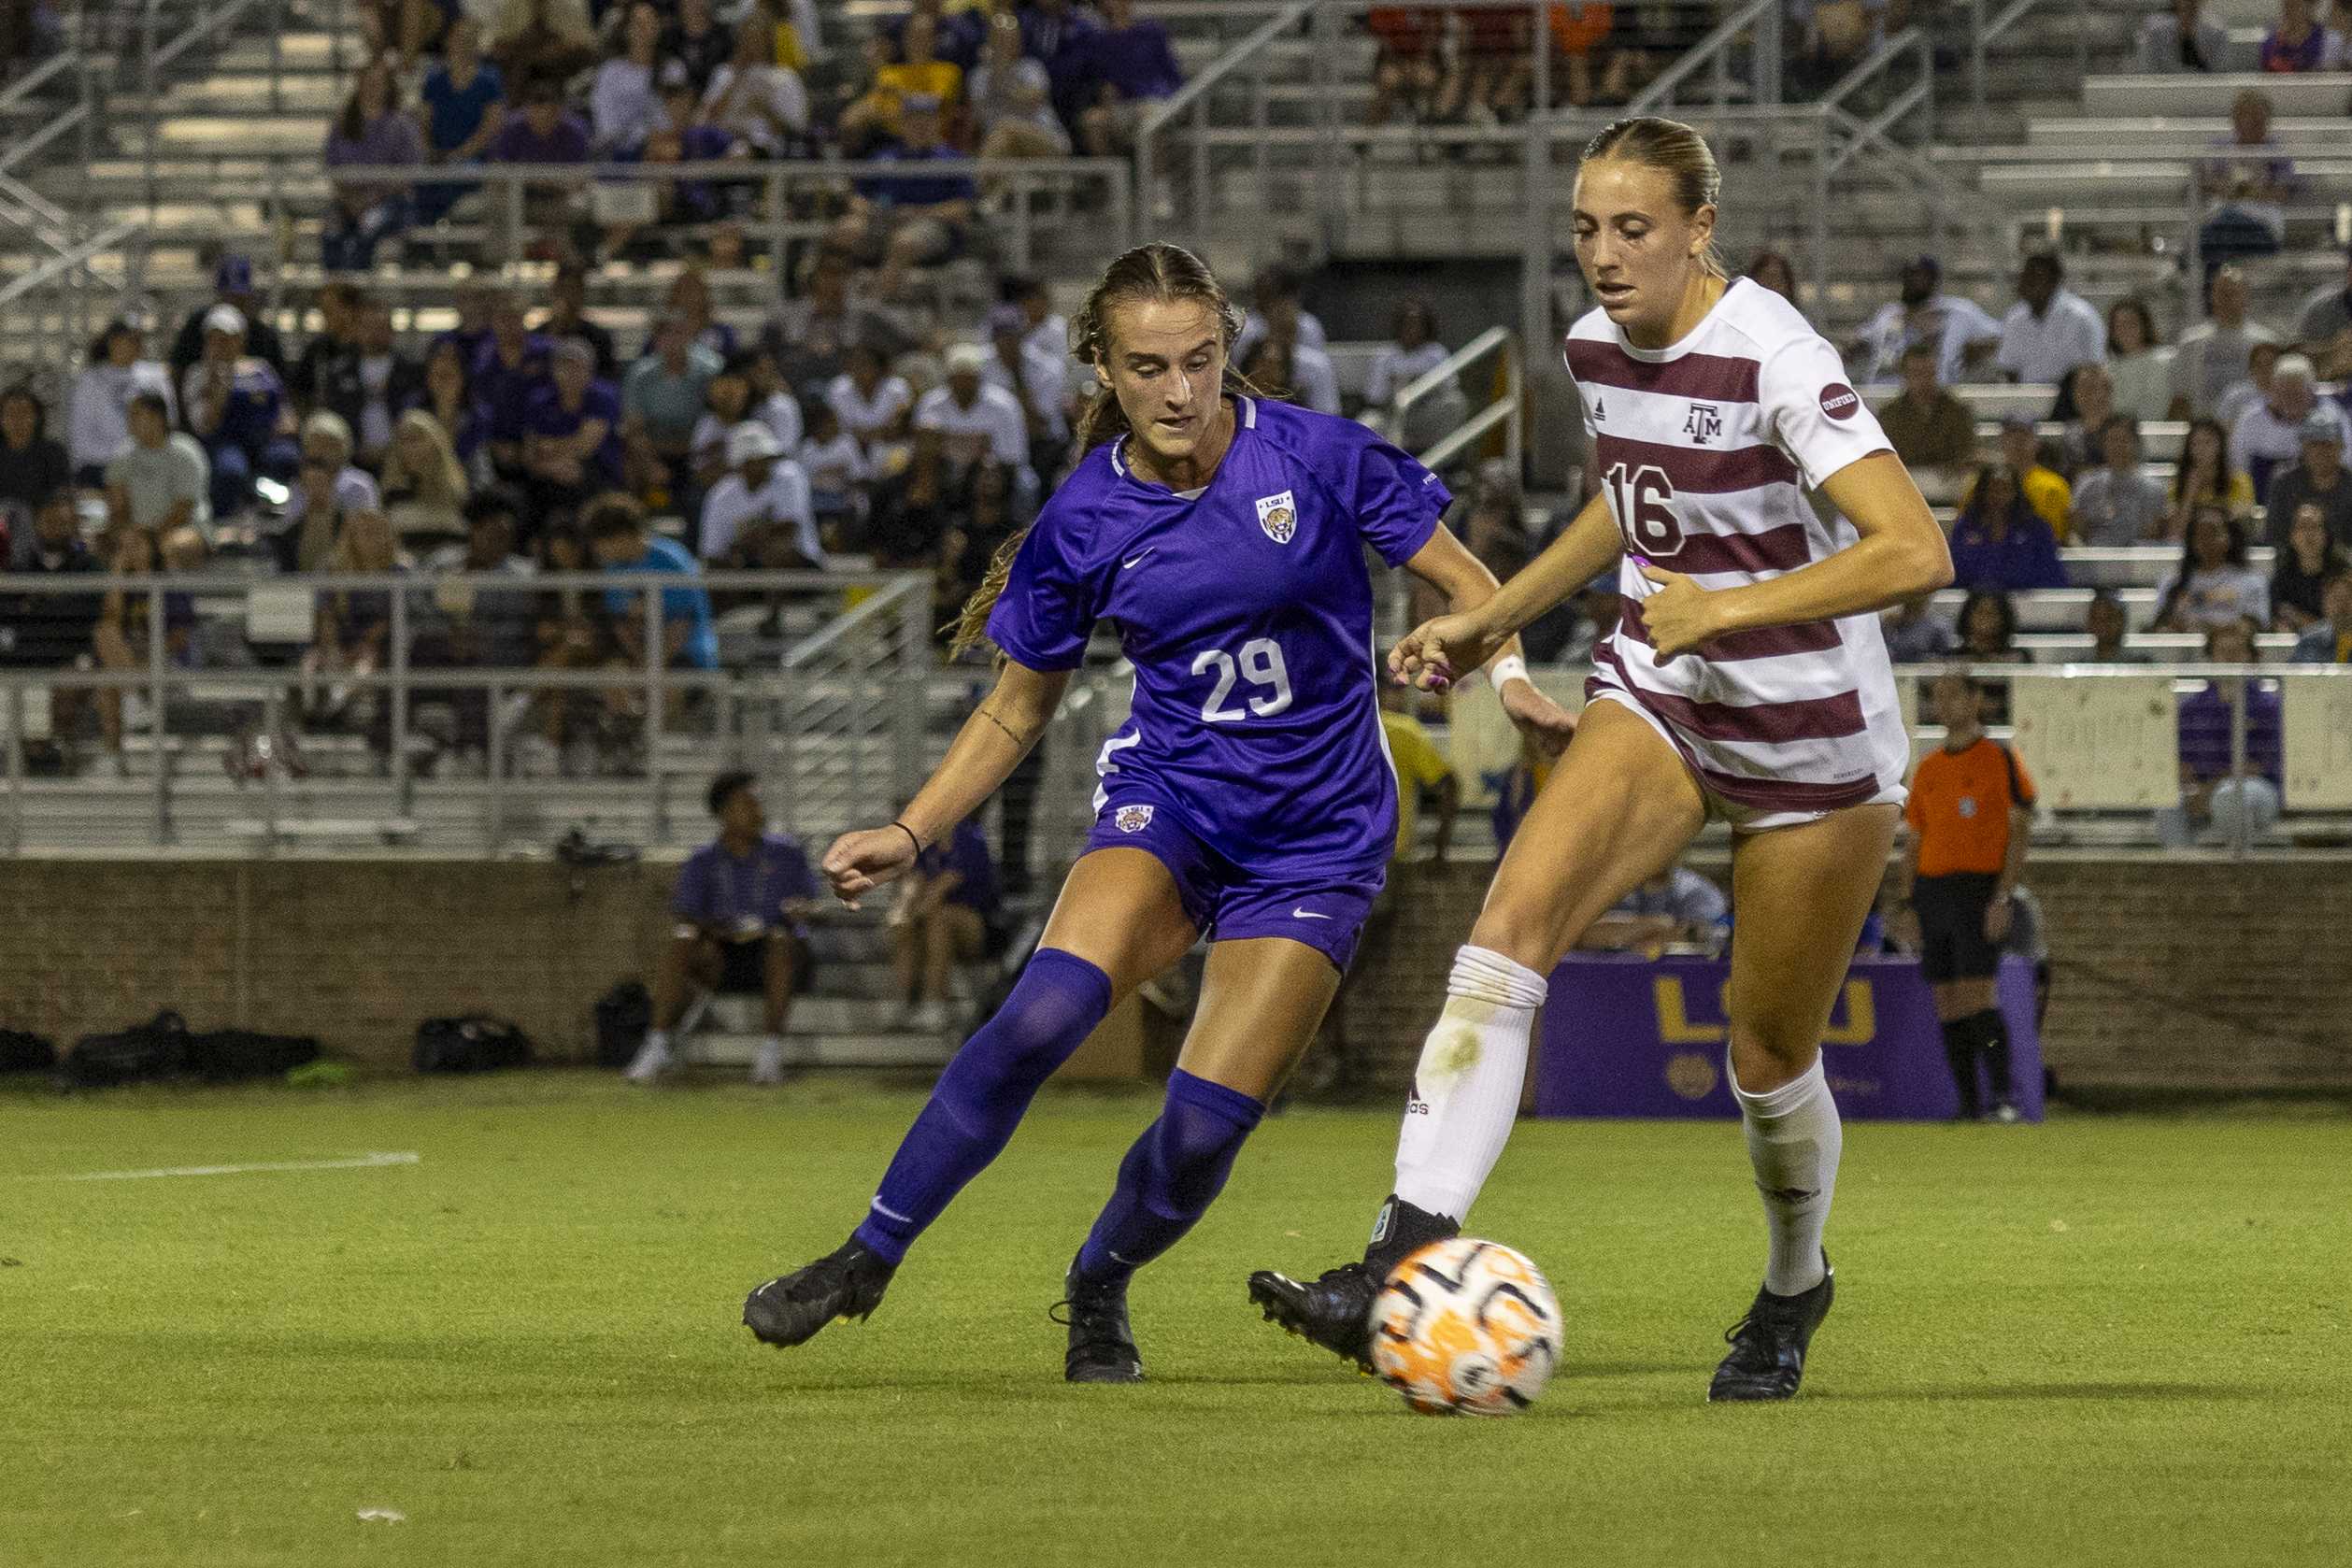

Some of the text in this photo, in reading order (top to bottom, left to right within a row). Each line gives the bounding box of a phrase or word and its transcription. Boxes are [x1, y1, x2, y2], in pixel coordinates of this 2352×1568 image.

[1822, 393, 1856, 411] UNIFIED
[1265, 497, 1284, 507] LSU
[1606, 462, 1687, 557] 16
[1191, 637, 1293, 722] 29
[1654, 976, 1876, 1044] LU
